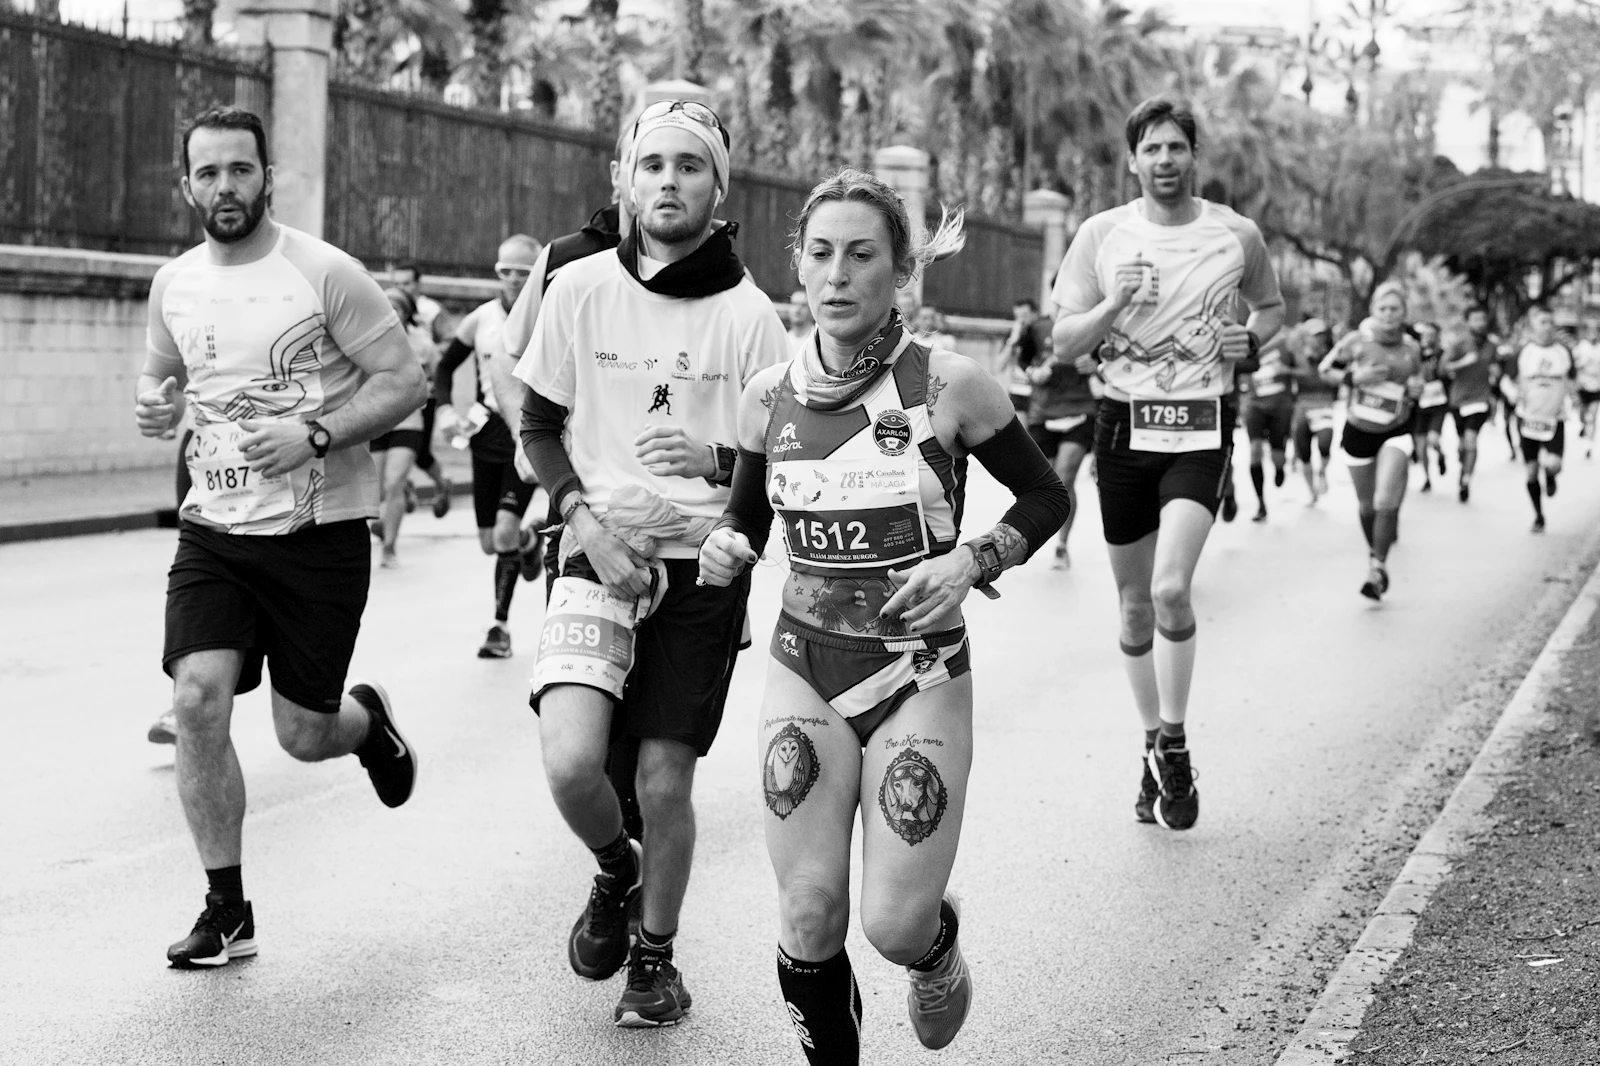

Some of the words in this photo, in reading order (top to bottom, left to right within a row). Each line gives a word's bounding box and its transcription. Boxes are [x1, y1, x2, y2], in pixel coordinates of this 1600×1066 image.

[1140, 405, 1189, 425] 1795
[877, 429, 909, 438] AXARLÓN
[206, 466, 250, 491] 8187
[795, 518, 870, 550] 1512
[540, 622, 600, 650] 5059
[922, 738, 944, 747] more
